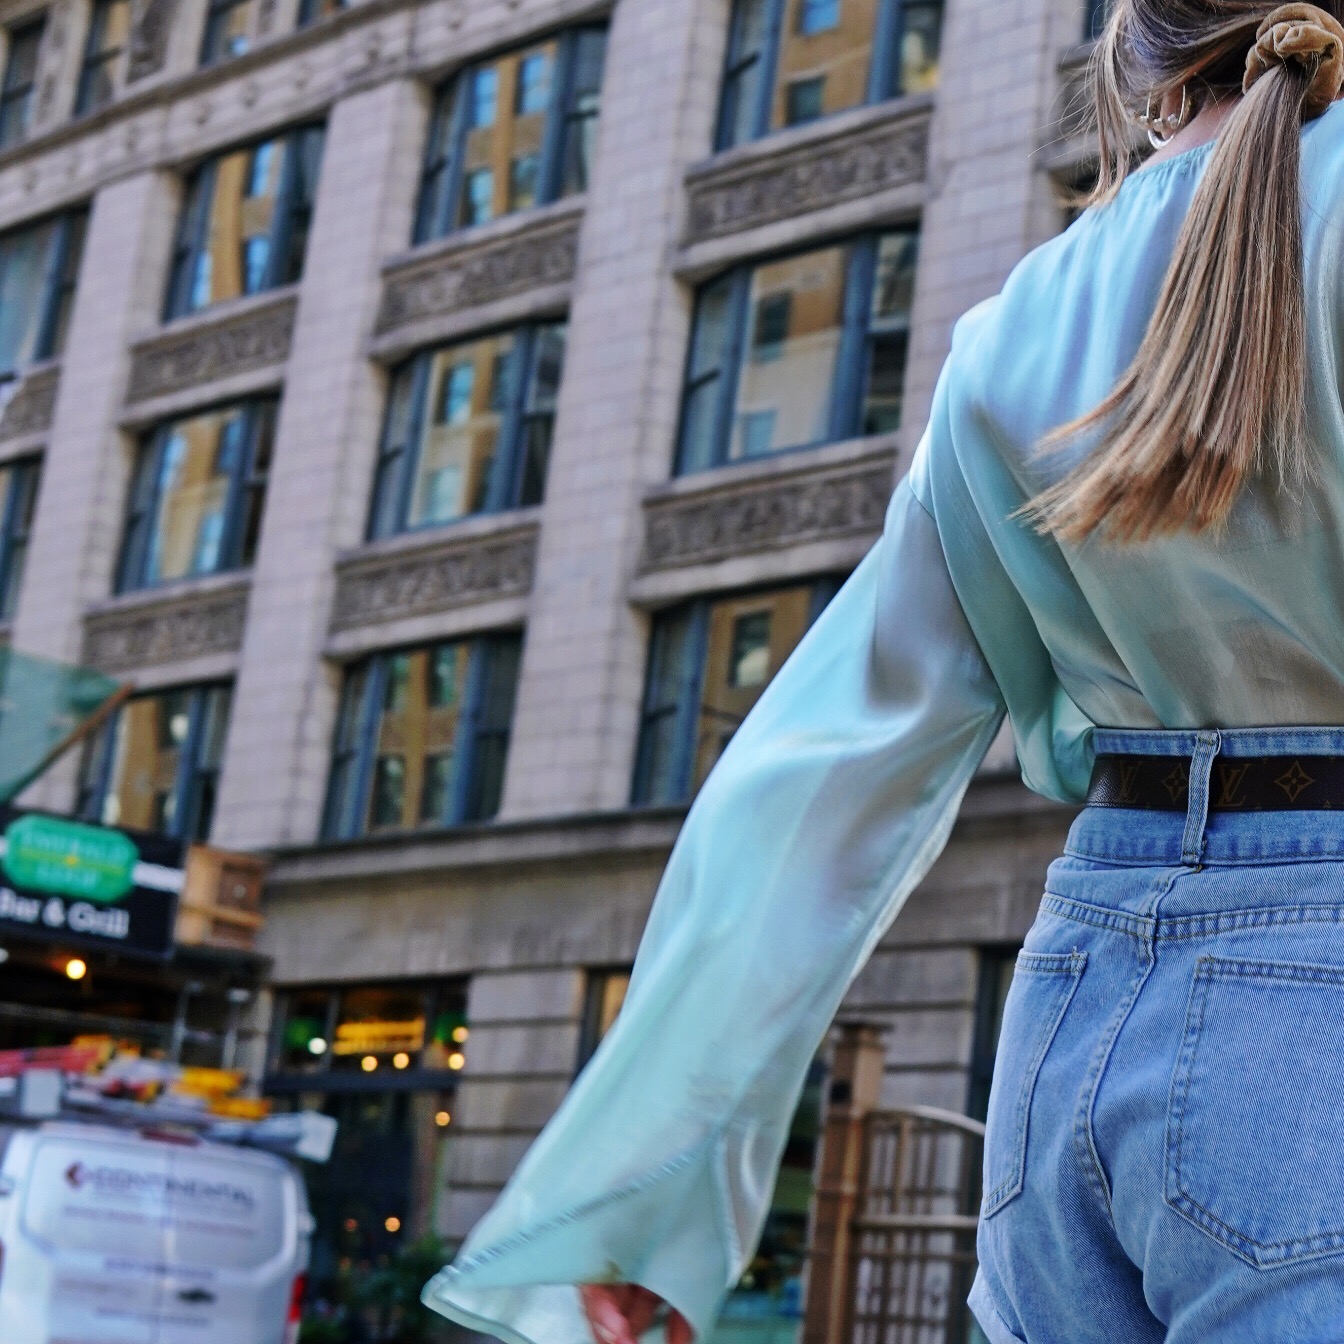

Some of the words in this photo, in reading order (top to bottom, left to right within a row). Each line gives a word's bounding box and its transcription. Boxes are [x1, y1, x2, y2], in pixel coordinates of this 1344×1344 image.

[1216, 762, 1250, 806] LV
[42, 896, 65, 928] &
[67, 901, 131, 940] Grill
